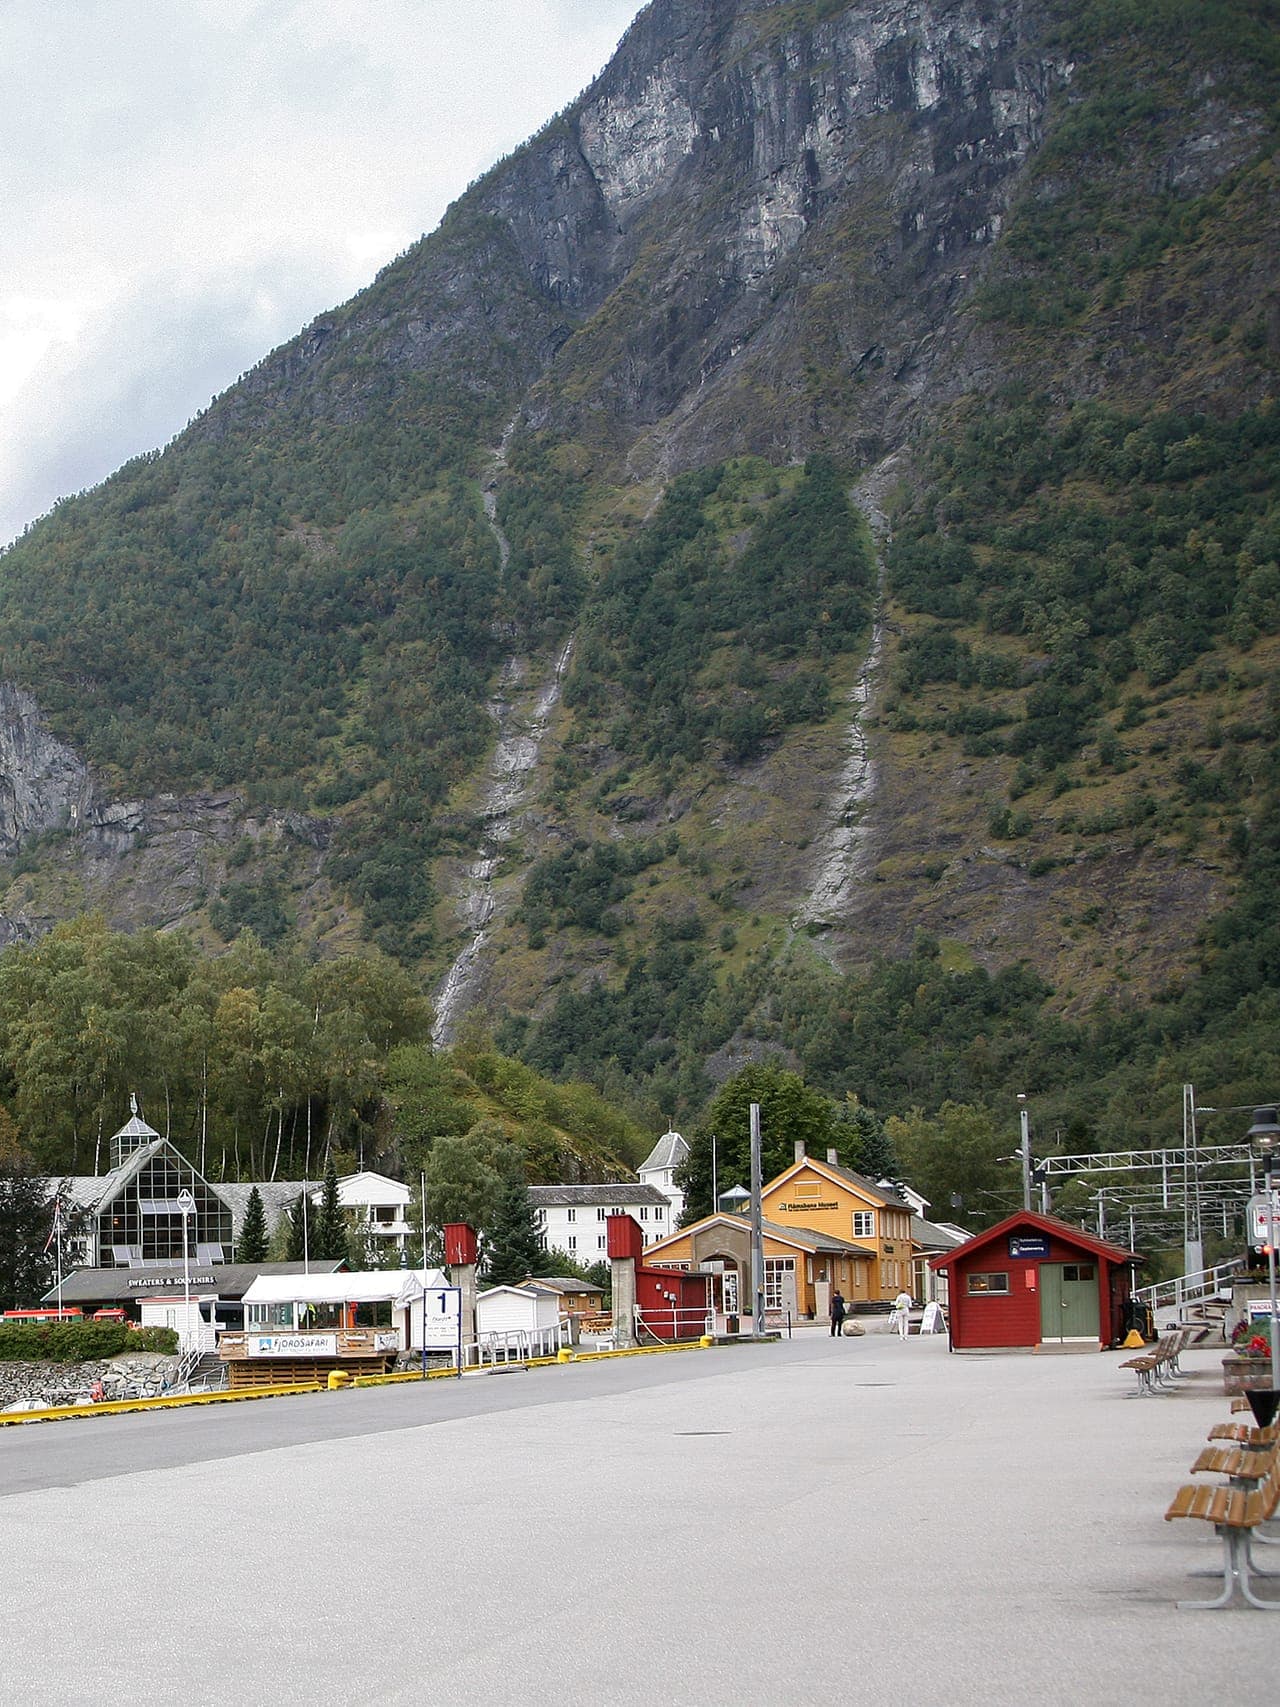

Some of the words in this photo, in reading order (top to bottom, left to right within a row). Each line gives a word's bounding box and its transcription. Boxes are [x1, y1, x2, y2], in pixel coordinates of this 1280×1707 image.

[128, 1279, 164, 1287] SWEATERS
[166, 1278, 172, 1286] &
[437, 1292, 446, 1314] 1
